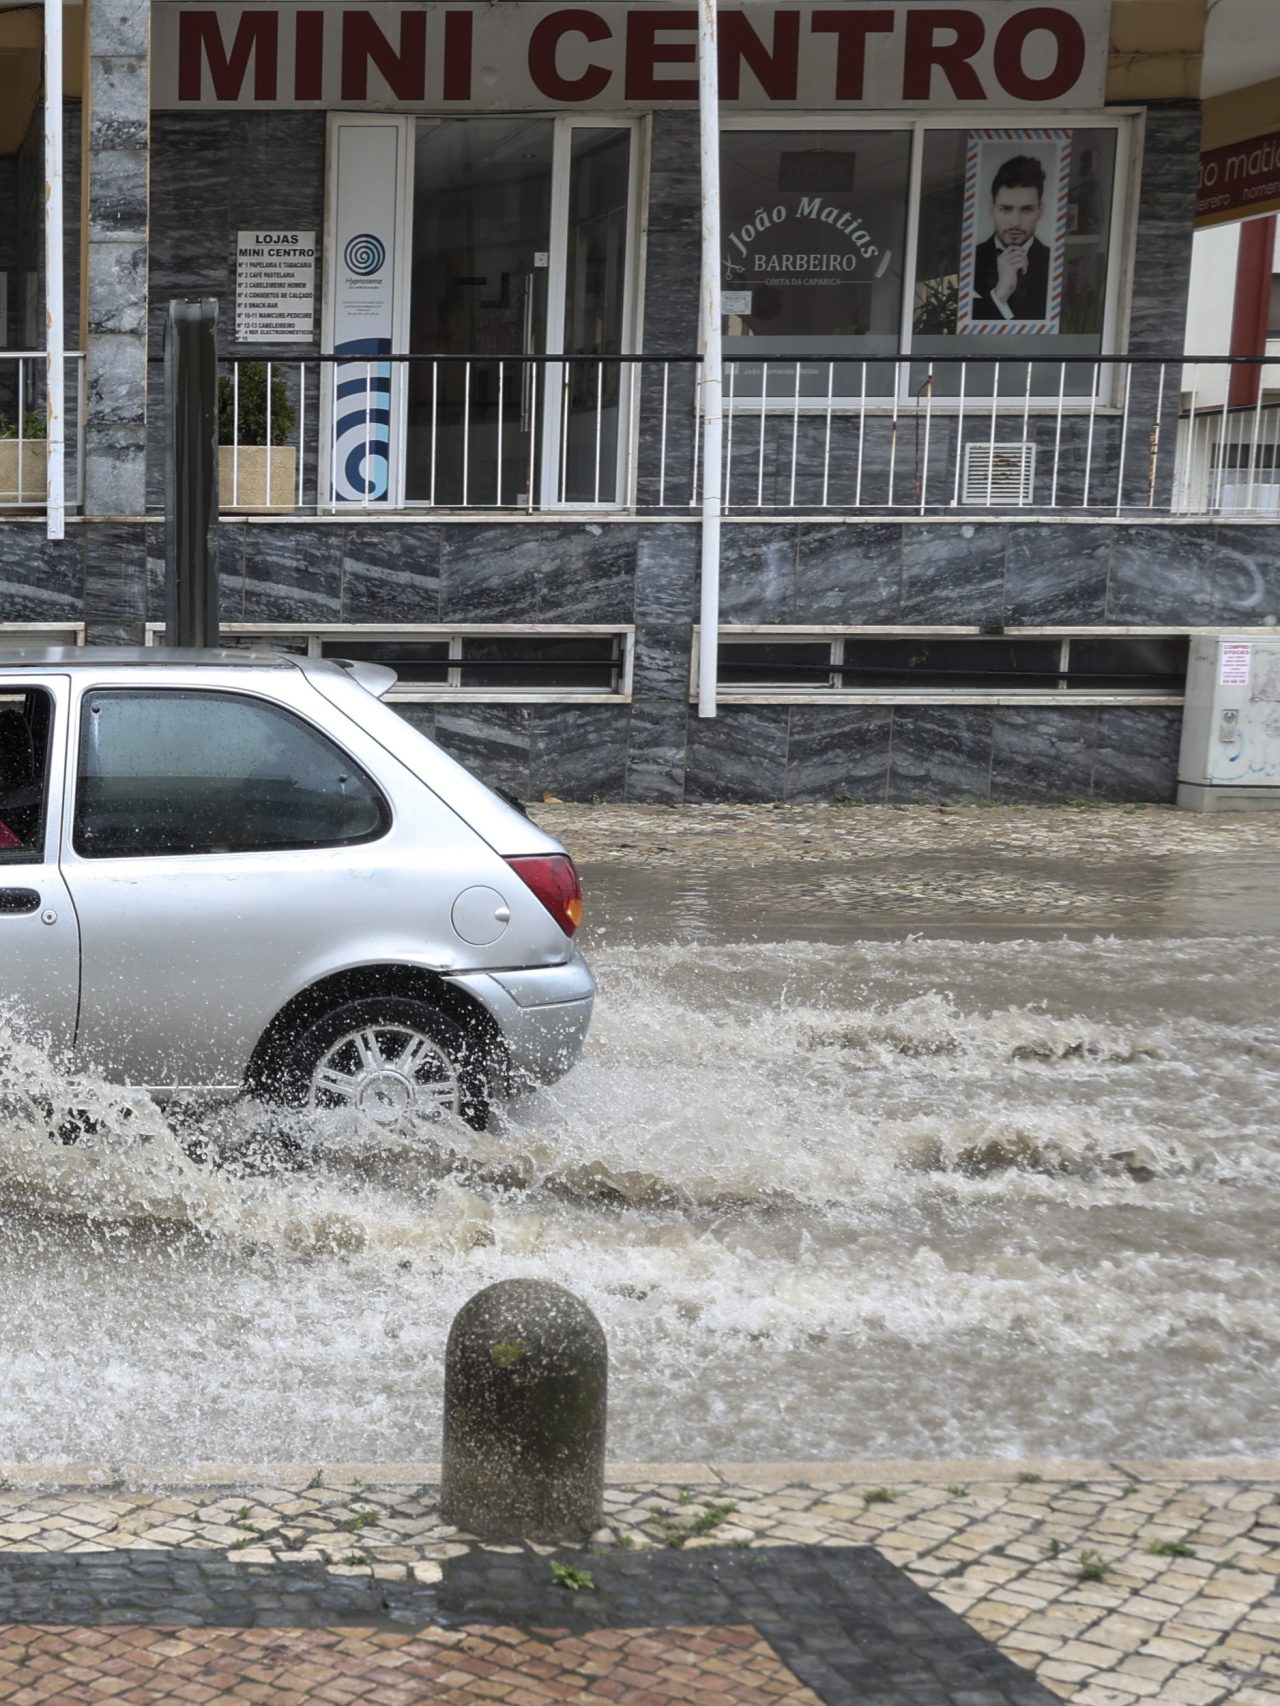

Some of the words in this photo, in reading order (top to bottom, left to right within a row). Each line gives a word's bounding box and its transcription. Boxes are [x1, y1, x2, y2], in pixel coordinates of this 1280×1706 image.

[178, 10, 474, 101] MINI
[528, 7, 1086, 102] CENTRO
[1197, 193, 1230, 211] eireiro
[728, 205, 787, 258] João
[795, 196, 879, 259] Matias
[255, 234, 299, 244] LOJAS
[239, 248, 264, 257] MINI
[267, 248, 315, 257] CENTRO
[753, 254, 857, 271] BARBEIRO
[765, 278, 790, 286] COSTA
[791, 278, 802, 286] DA
